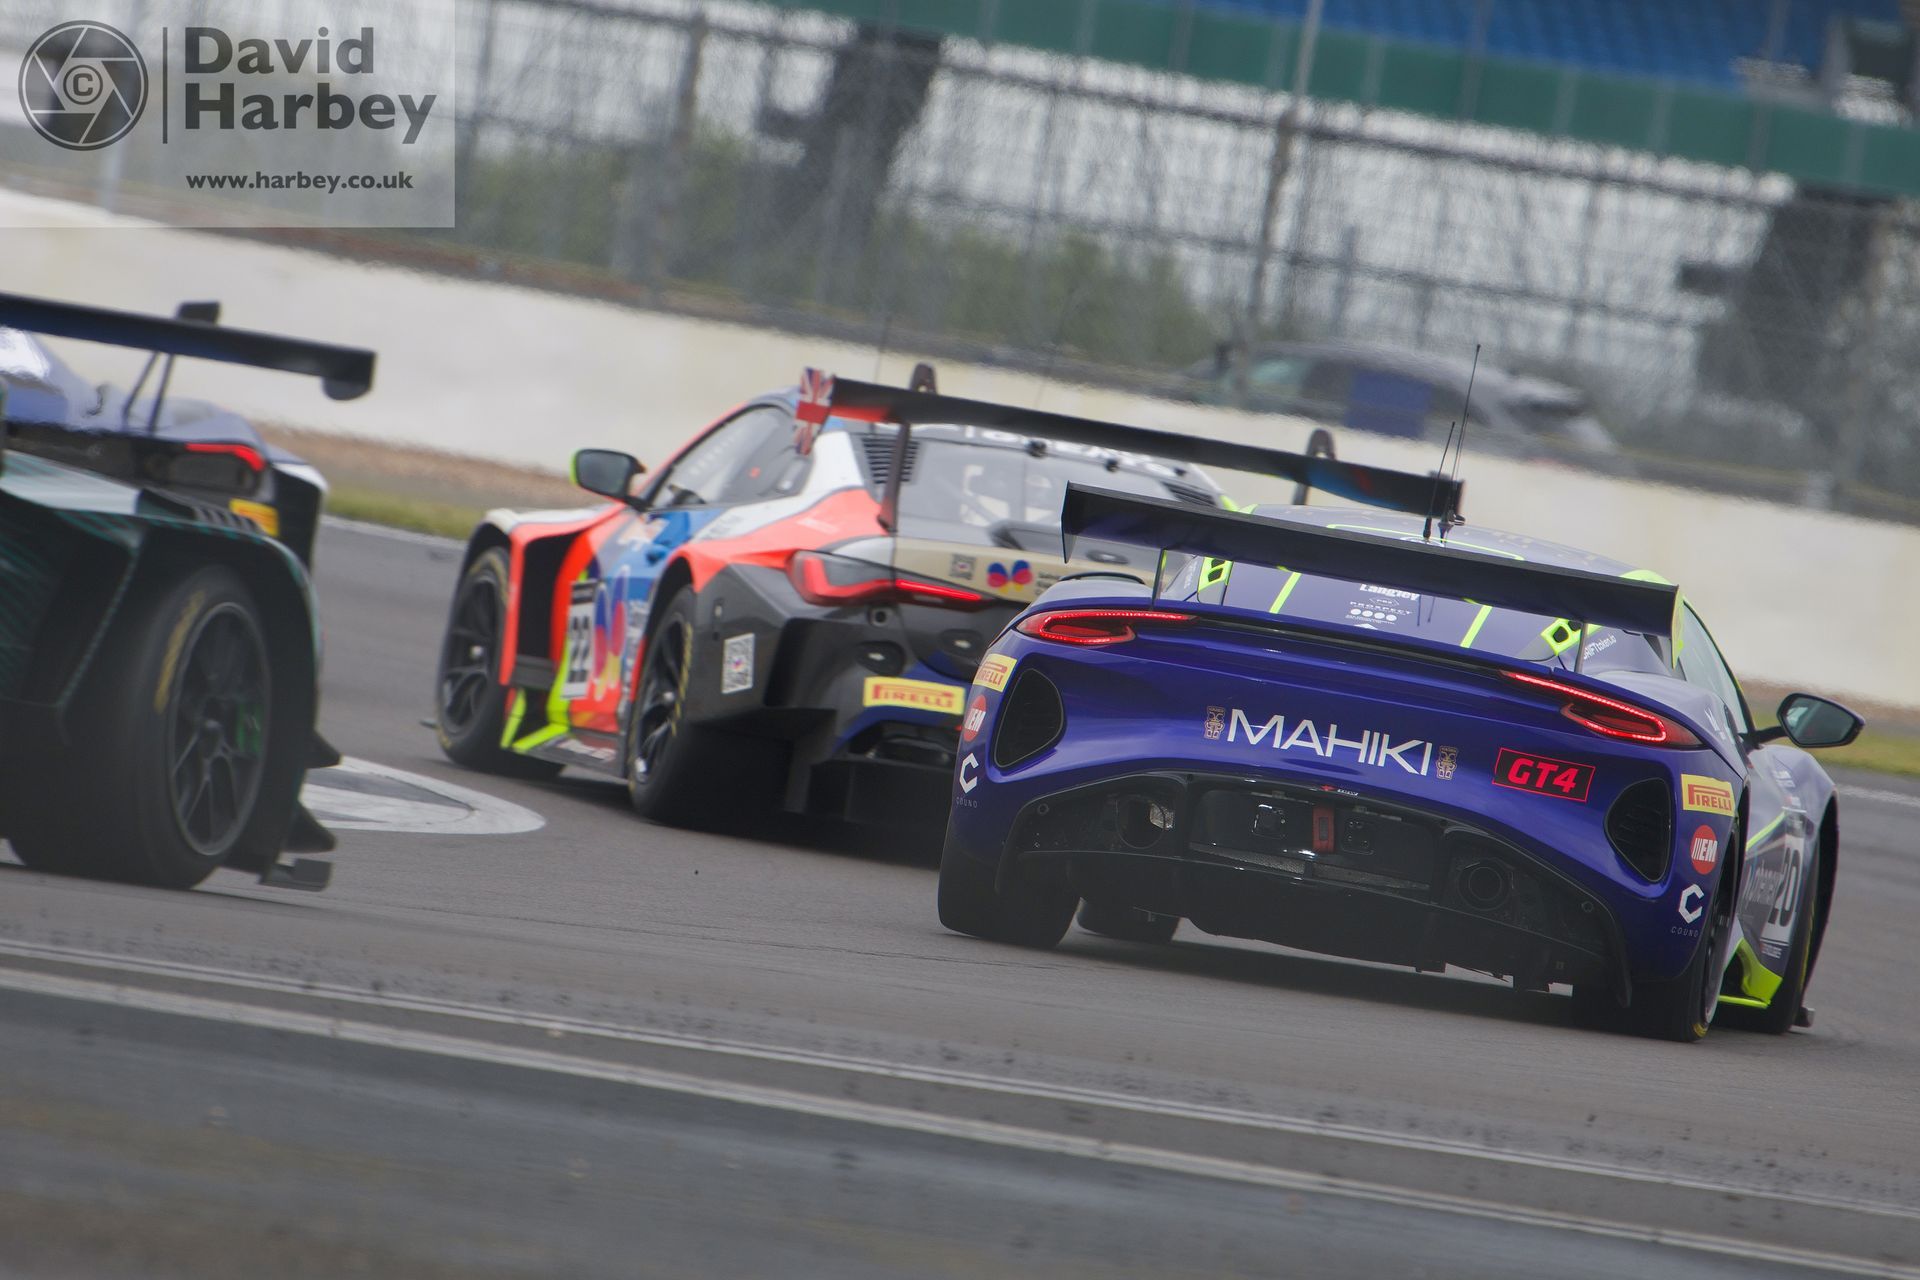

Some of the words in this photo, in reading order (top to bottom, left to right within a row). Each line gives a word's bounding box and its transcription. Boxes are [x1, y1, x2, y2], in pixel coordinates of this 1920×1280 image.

[872, 684, 954, 708] PIRELLI
[1227, 708, 1433, 776] MAHIKI
[1507, 758, 1579, 793] GT4
[1688, 784, 1732, 811] PIRELLI
[1767, 846, 1801, 927] 20
